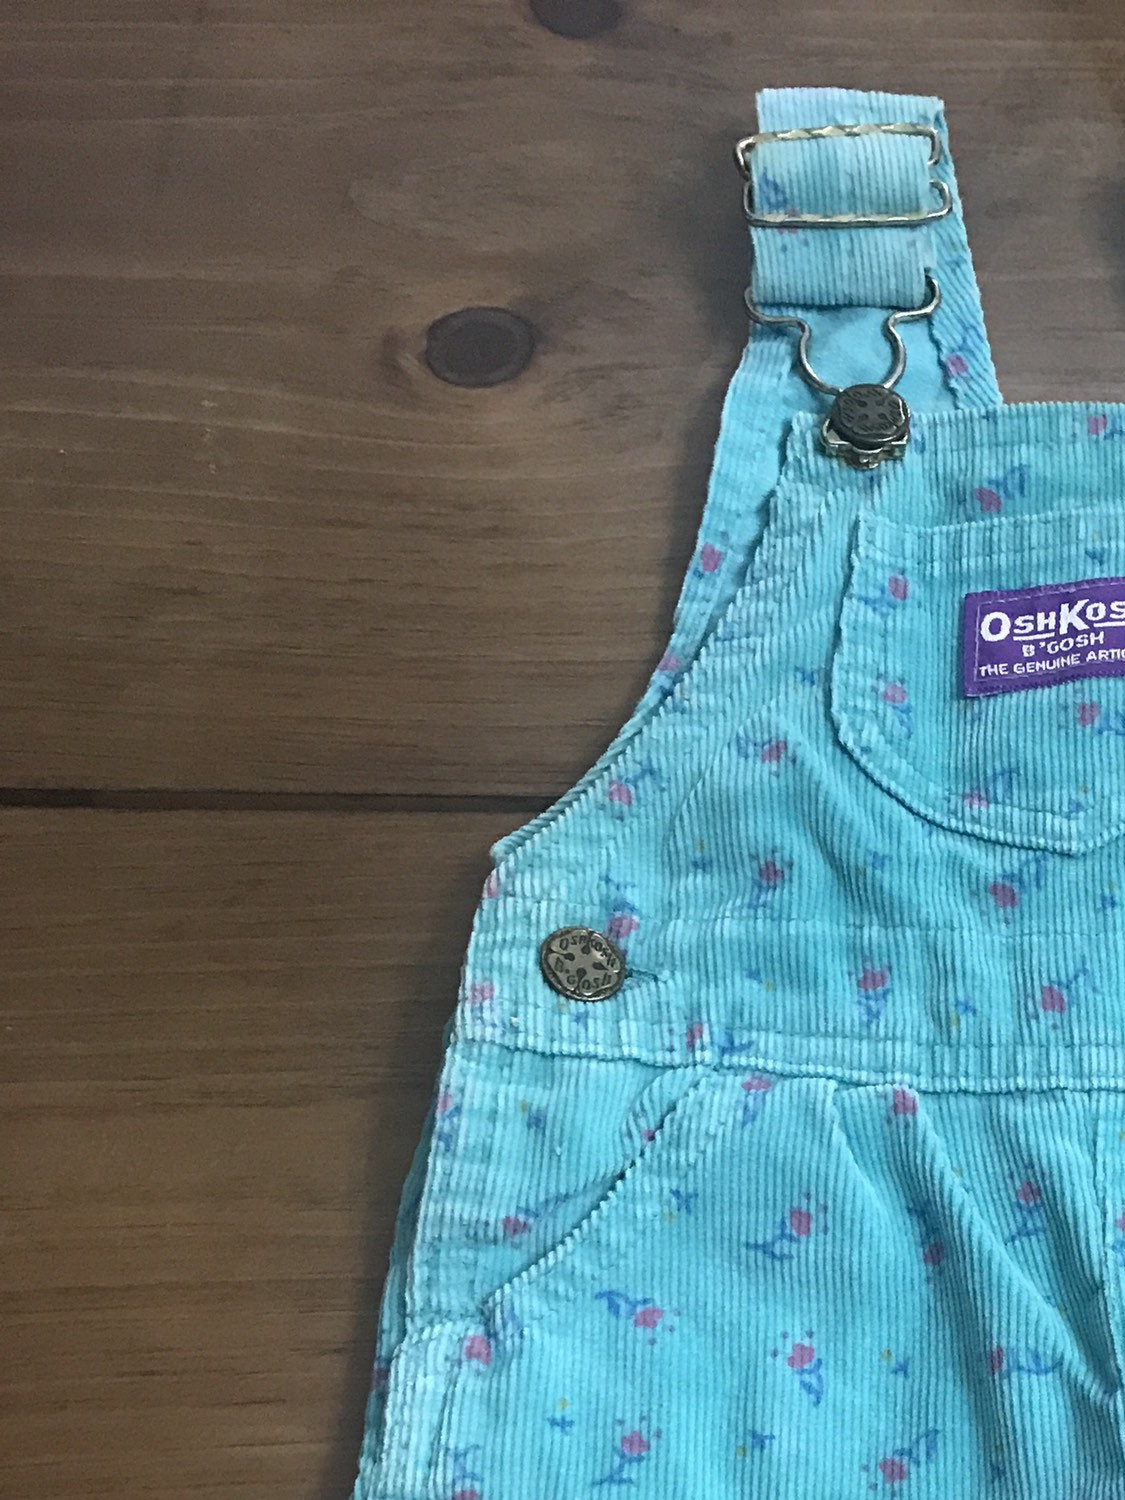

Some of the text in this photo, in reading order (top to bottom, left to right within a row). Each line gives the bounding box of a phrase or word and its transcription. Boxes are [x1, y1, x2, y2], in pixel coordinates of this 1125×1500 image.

[1021, 630, 1105, 658] B'GOSH
[979, 662, 1009, 677] THE
[1013, 653, 1081, 675] GENUINE
